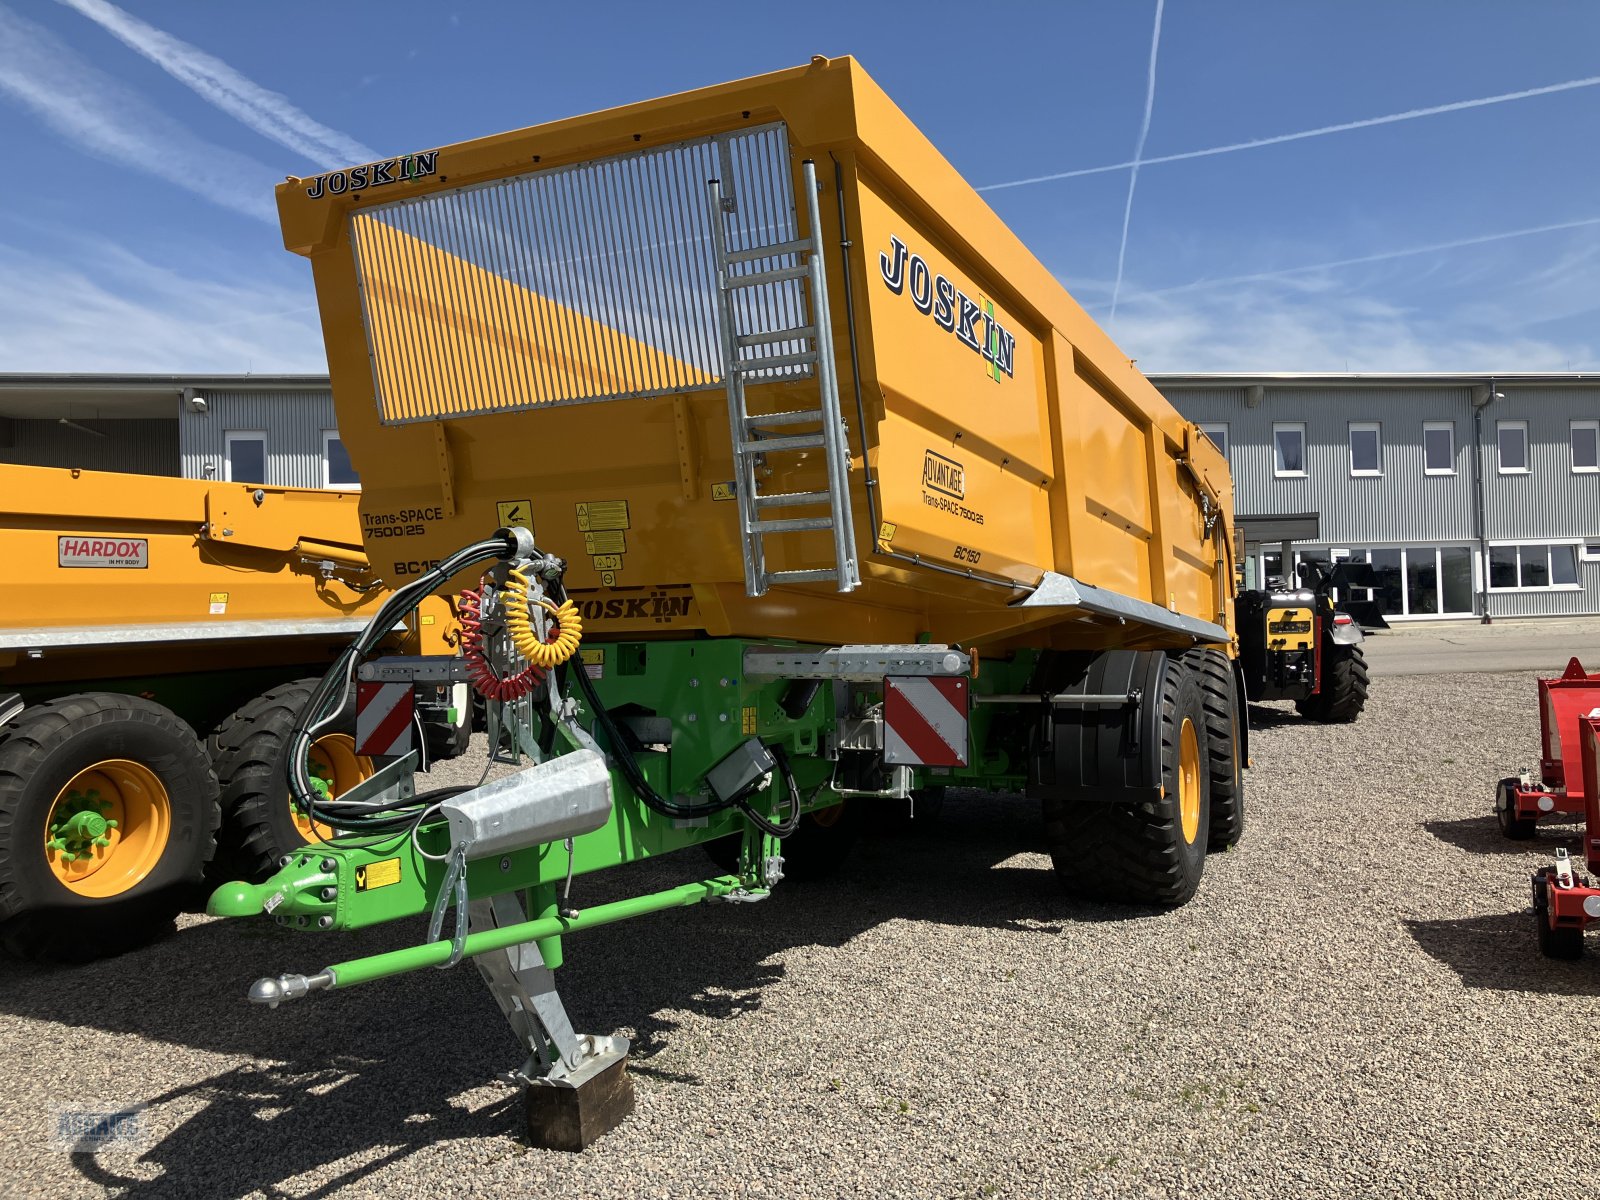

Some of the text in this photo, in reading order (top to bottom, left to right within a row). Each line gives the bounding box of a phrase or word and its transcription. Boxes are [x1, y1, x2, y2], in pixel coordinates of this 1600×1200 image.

[307, 151, 439, 198] JOSKIN
[879, 233, 1016, 379] JOSKIN
[922, 456, 962, 492] ADVANTAGE
[363, 507, 443, 525] Trans-SPACE
[922, 490, 959, 516] Trans-SPACE
[953, 545, 981, 564] BC150
